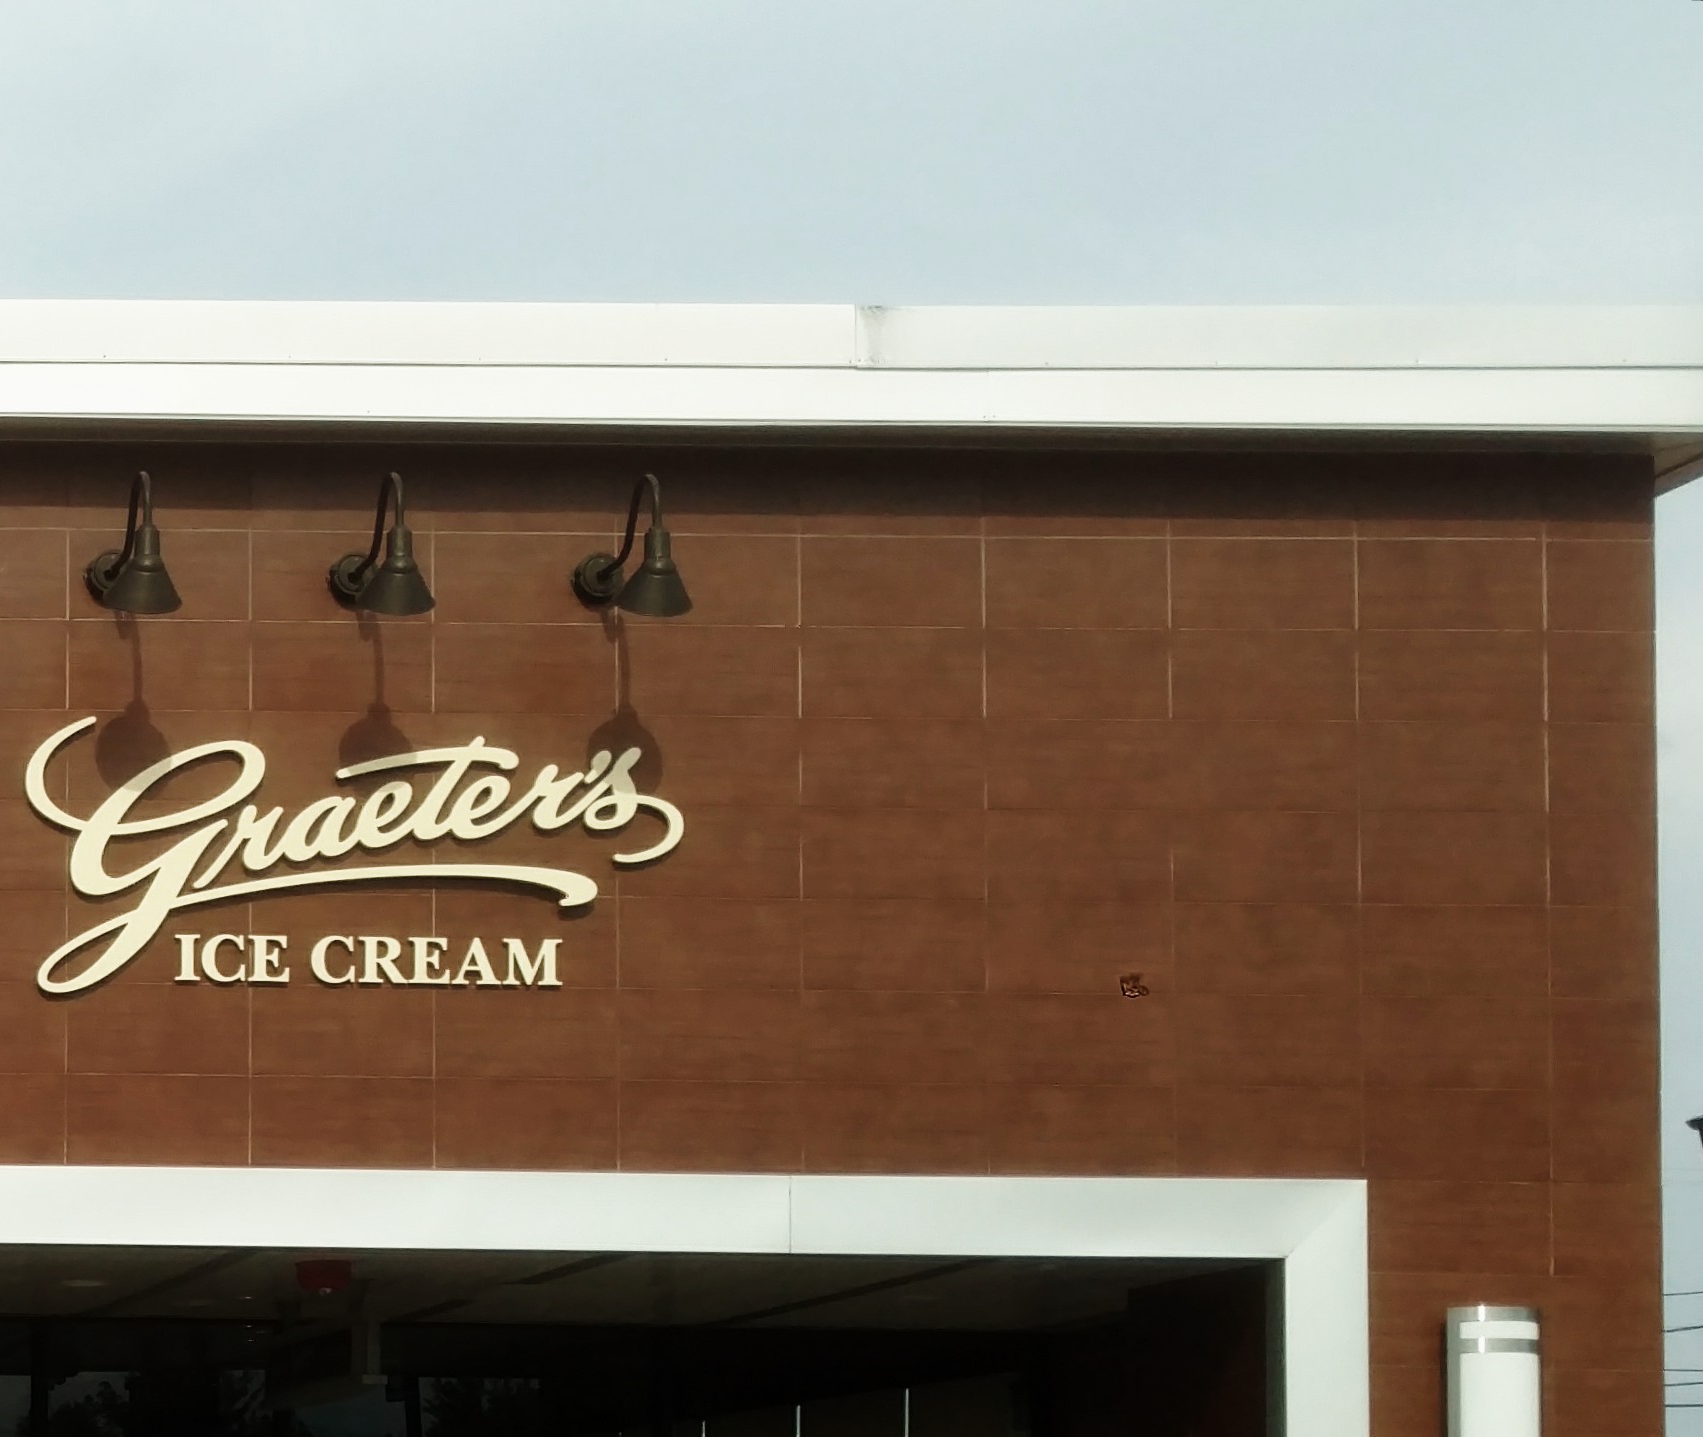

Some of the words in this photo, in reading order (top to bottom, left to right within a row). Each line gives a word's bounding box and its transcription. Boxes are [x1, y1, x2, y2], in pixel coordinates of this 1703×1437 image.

[26, 716, 685, 994] Graeter's
[174, 933, 290, 983] ICE
[310, 935, 563, 986] CREAM
